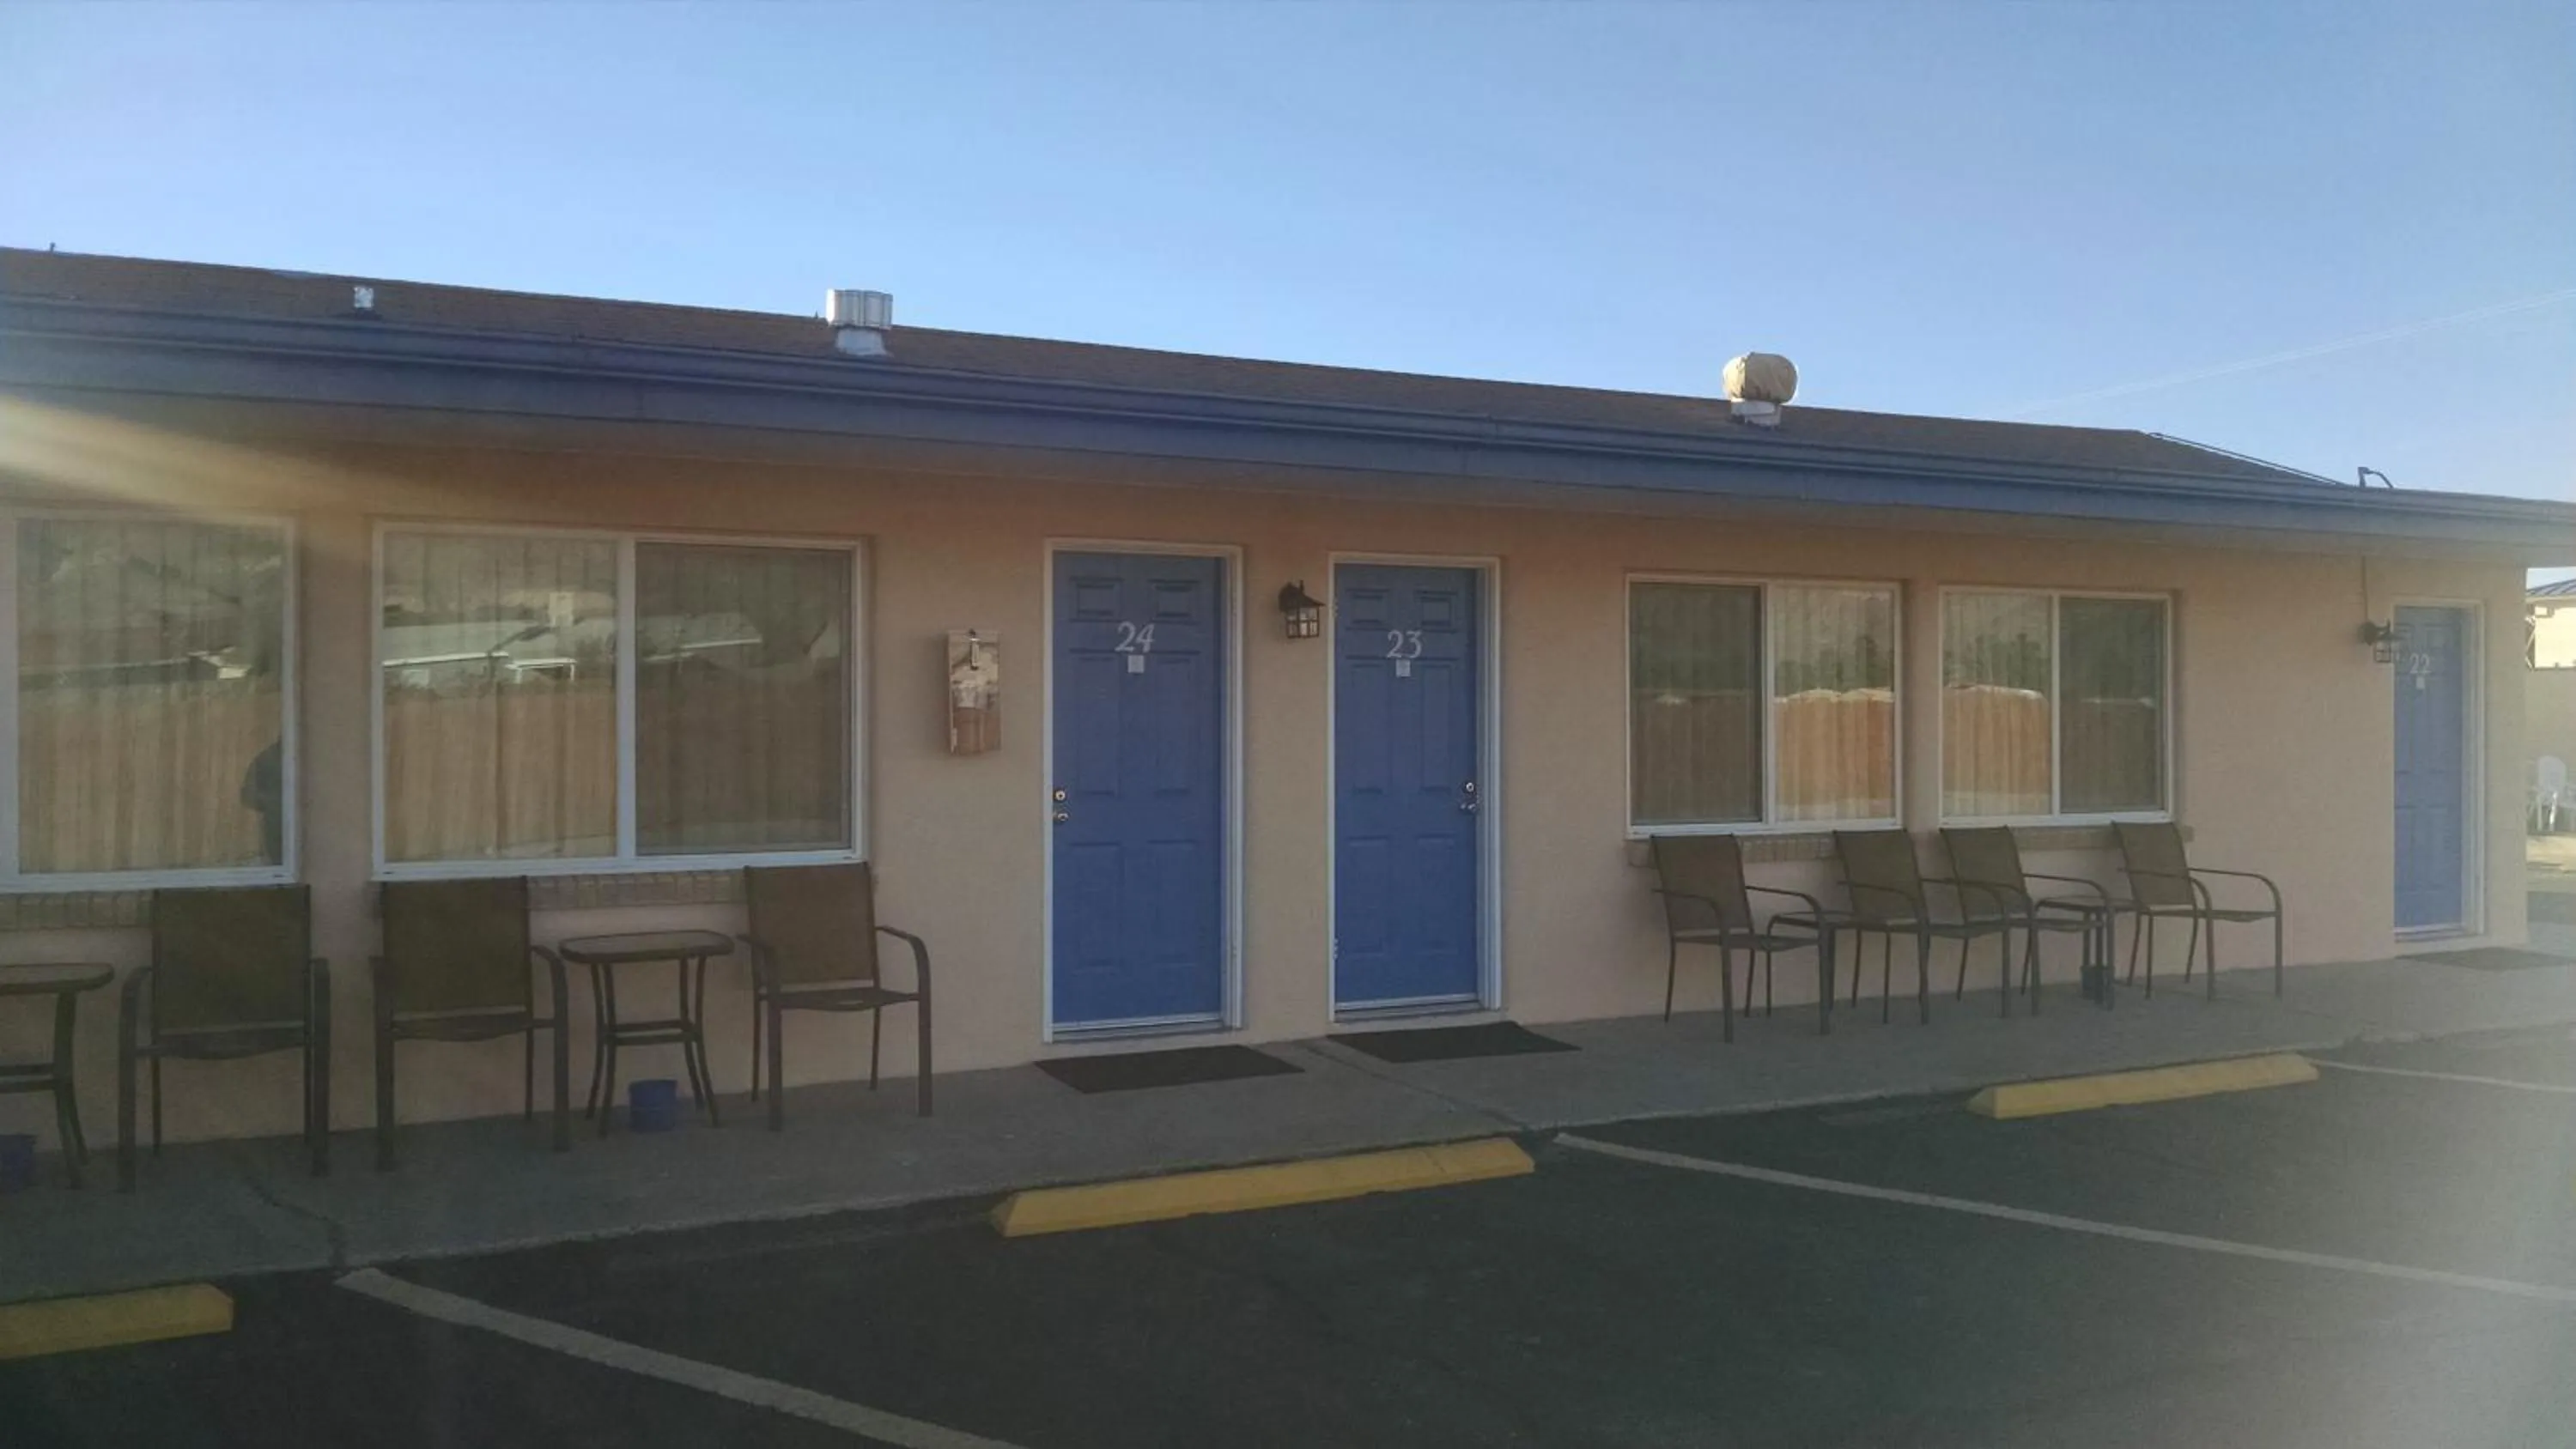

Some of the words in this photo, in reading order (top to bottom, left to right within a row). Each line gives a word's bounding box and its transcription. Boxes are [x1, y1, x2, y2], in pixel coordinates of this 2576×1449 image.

[1115, 621, 1155, 653] 24
[1386, 629, 1422, 658] 23
[2409, 652, 2431, 674] 22
